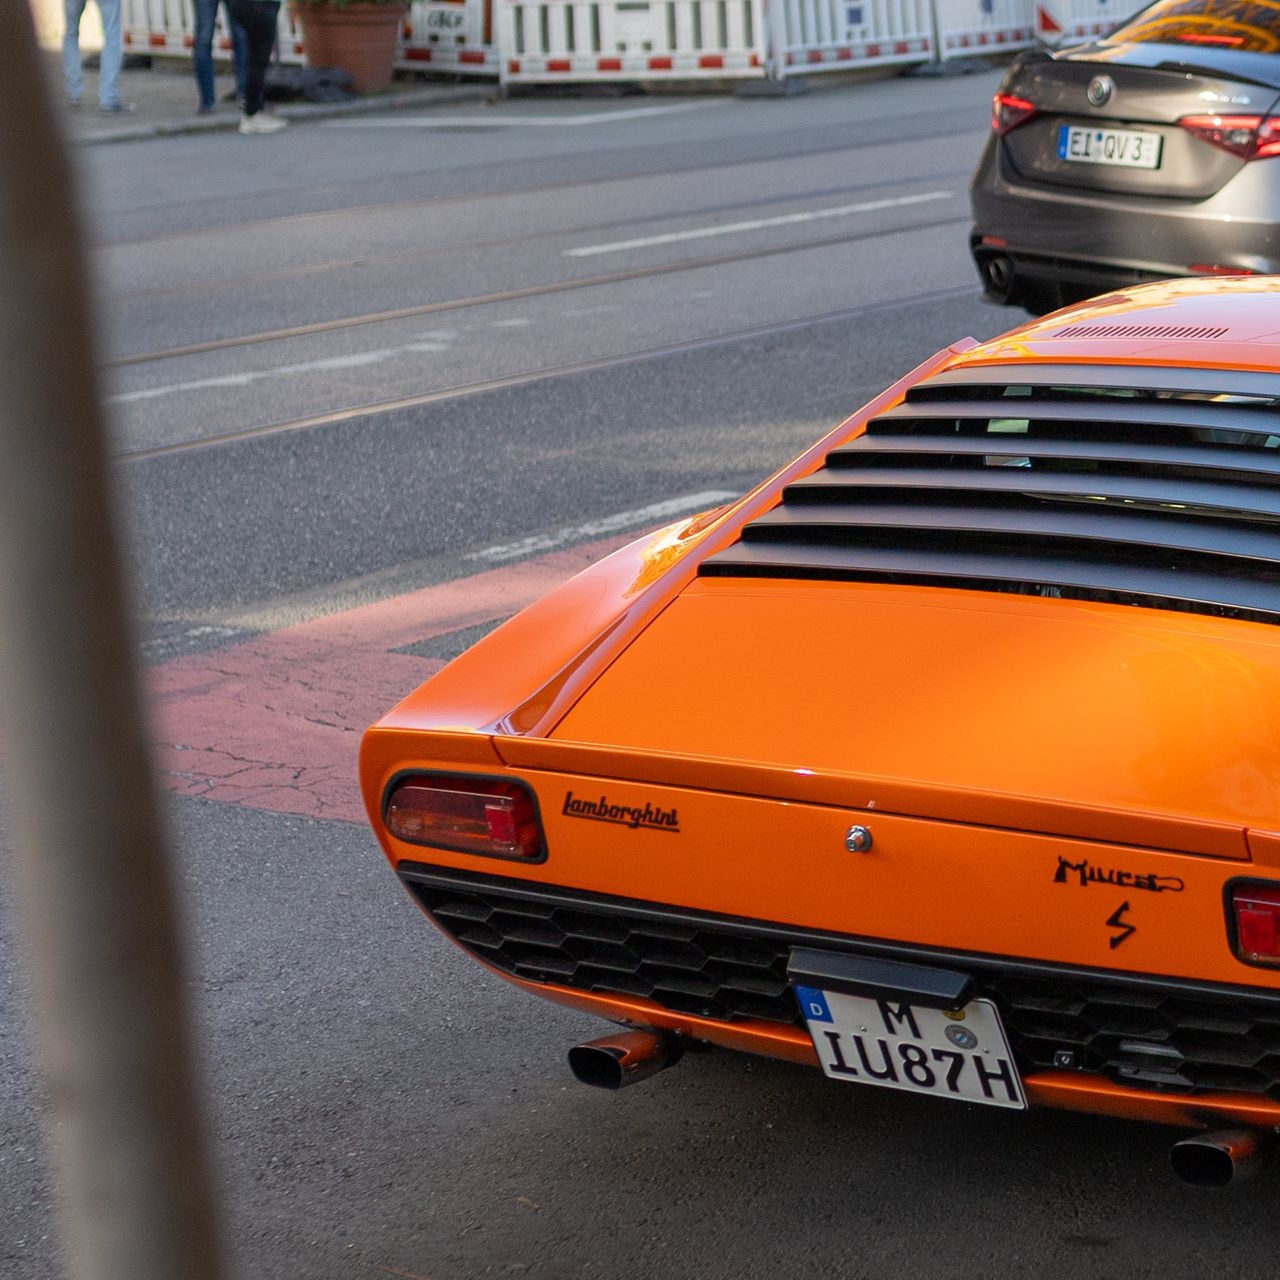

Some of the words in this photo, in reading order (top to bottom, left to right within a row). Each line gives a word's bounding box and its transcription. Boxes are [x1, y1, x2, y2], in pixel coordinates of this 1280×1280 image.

[1053, 855, 1184, 892] Miura
[1105, 901, 1137, 950] S
[809, 1002, 823, 1017] D
[874, 999, 922, 1040] M
